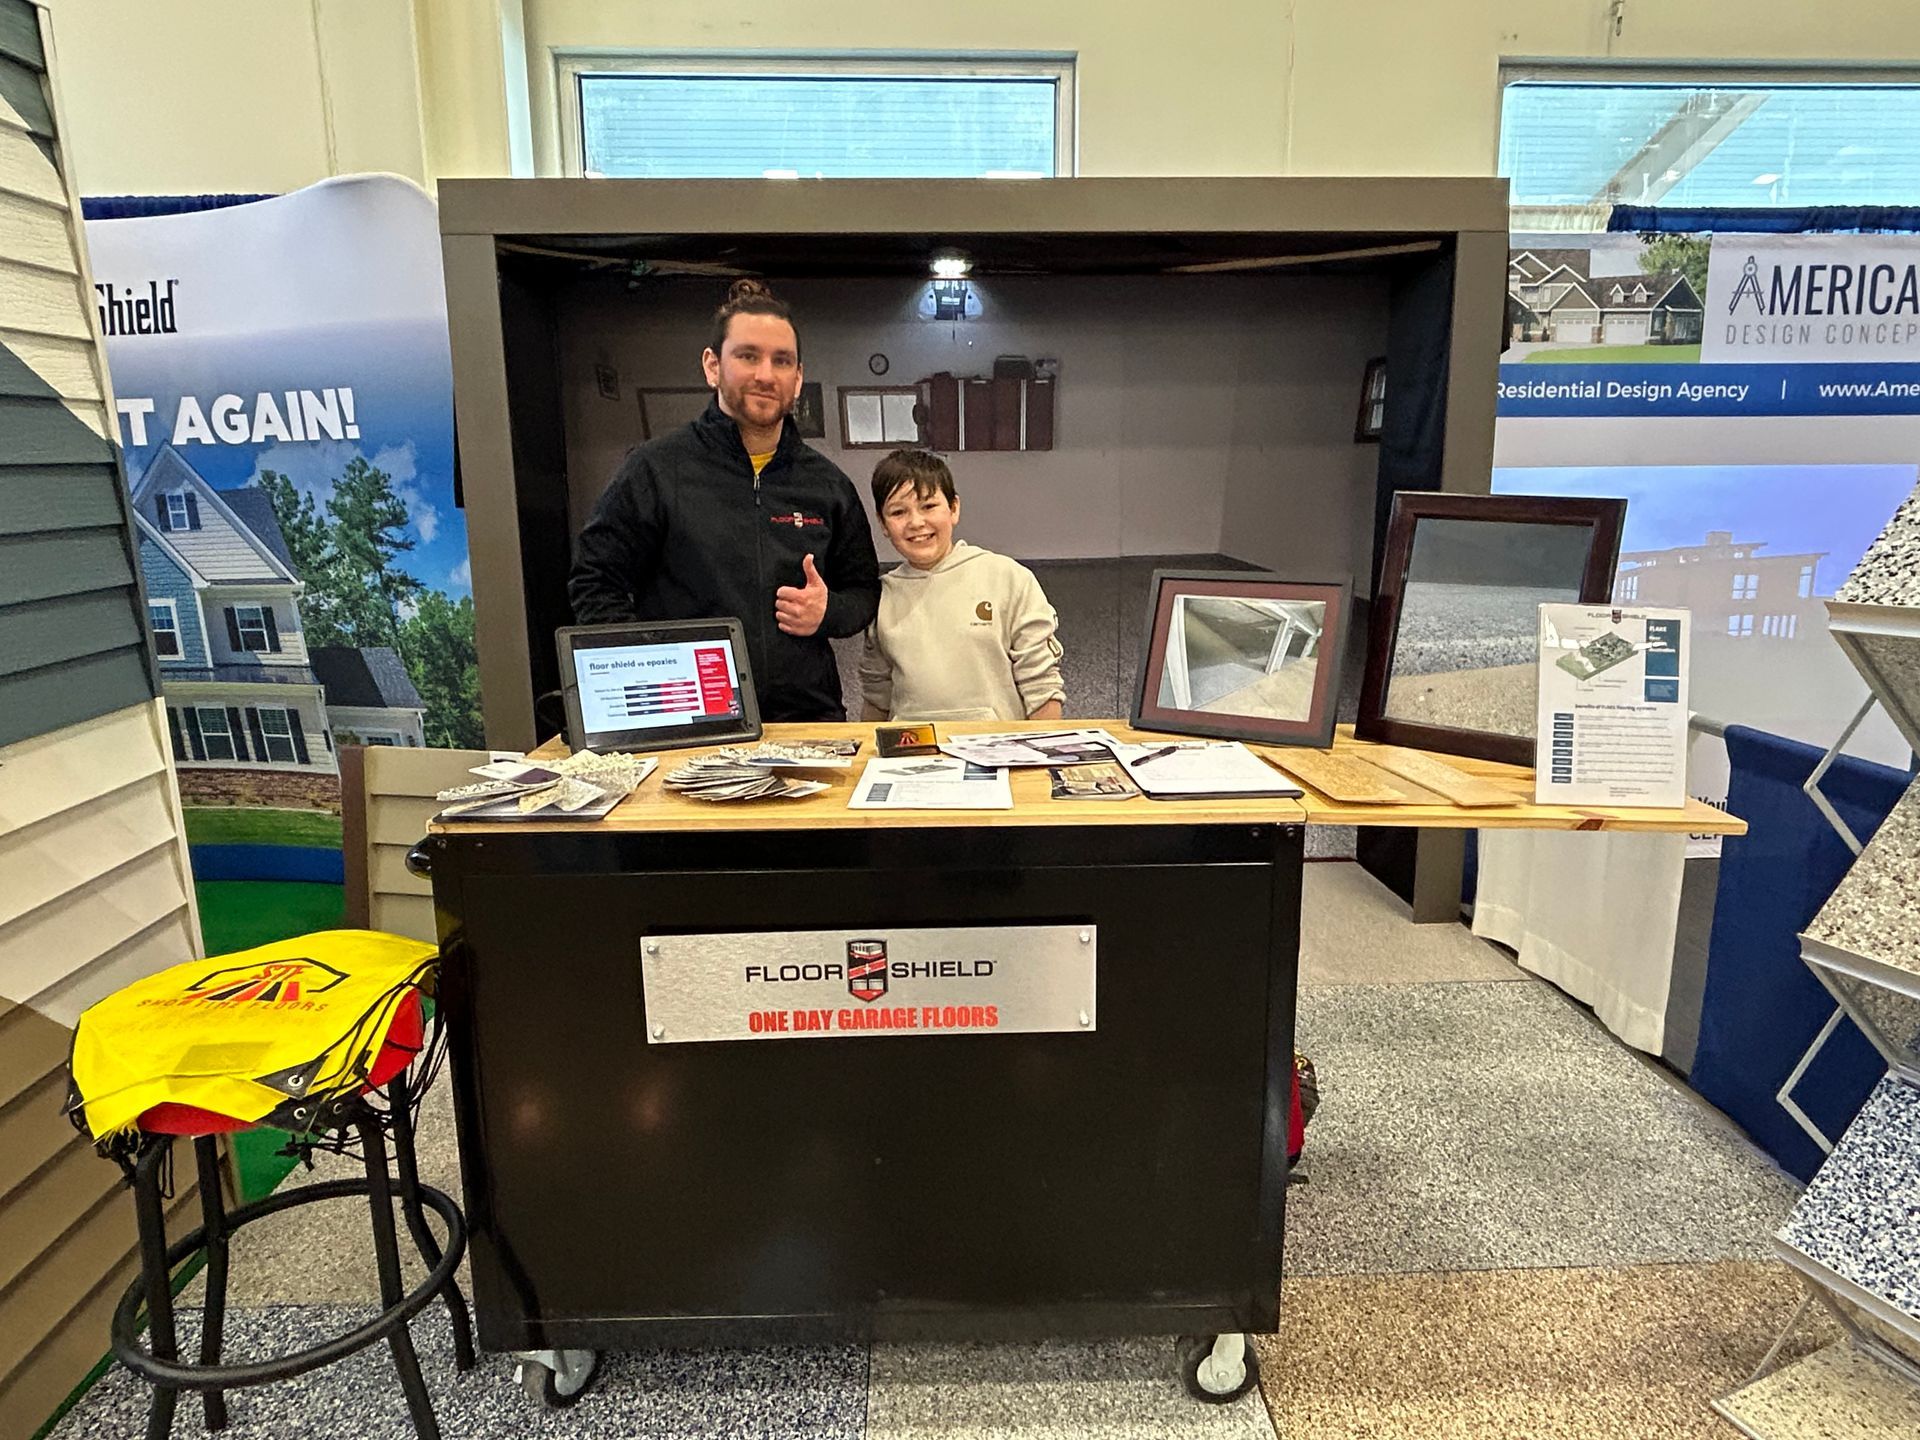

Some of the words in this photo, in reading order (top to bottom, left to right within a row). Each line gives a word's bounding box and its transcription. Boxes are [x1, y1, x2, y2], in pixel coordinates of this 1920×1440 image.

[1726, 324, 1811, 345] DESIGN
[1826, 323, 1918, 345] CONCEP
[1498, 381, 1601, 399] Residential
[1606, 381, 1671, 402] Design
[1676, 382, 1749, 402] Agency
[172, 387, 360, 446] AGAIN!
[589, 662, 609, 671] floor
[610, 660, 636, 669] shield
[646, 658, 678, 668] epoxies
[745, 963, 843, 983] FLOOR
[891, 960, 995, 979] SHIELD
[247, 1001, 328, 1012] FLOORS
[749, 1010, 788, 1033] ONE
[793, 1009, 834, 1032] DAY
[837, 1007, 918, 1031] GARAGE
[922, 1005, 999, 1028] FLOORS
